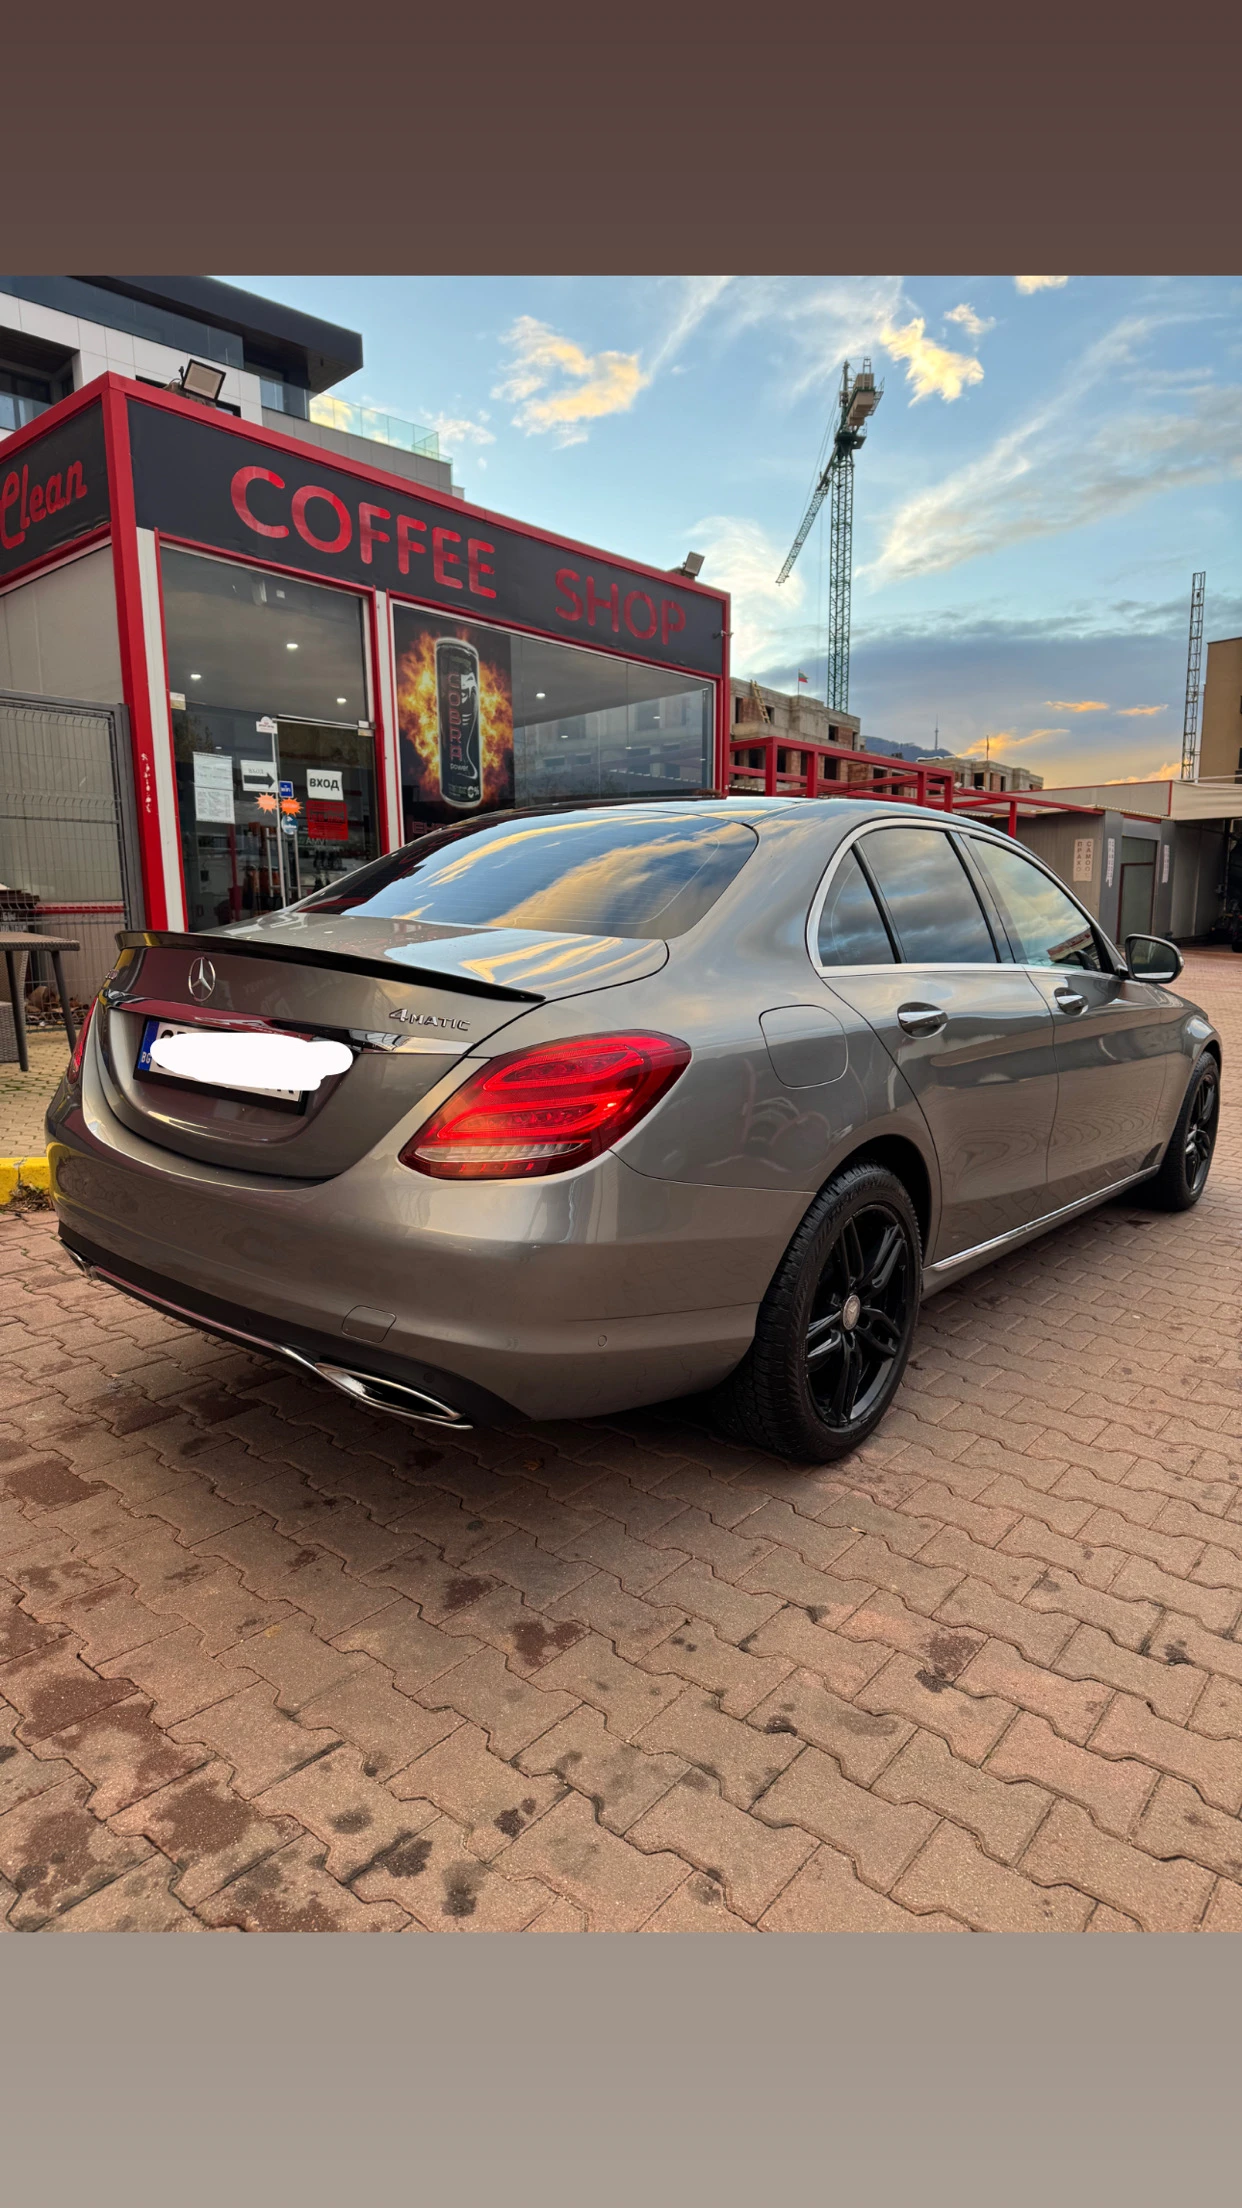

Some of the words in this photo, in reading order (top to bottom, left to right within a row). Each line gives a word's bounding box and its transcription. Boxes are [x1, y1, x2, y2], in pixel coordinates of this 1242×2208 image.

[0, 460, 88, 550] Clean
[230, 465, 497, 599] COFFEE
[554, 568, 687, 646] SHOP
[448, 672, 463, 761] COBRA
[450, 763, 469, 772] power
[309, 777, 340, 792] ВХОД
[388, 1007, 471, 1032] 4MATIC
[140, 1050, 152, 1065] BG
